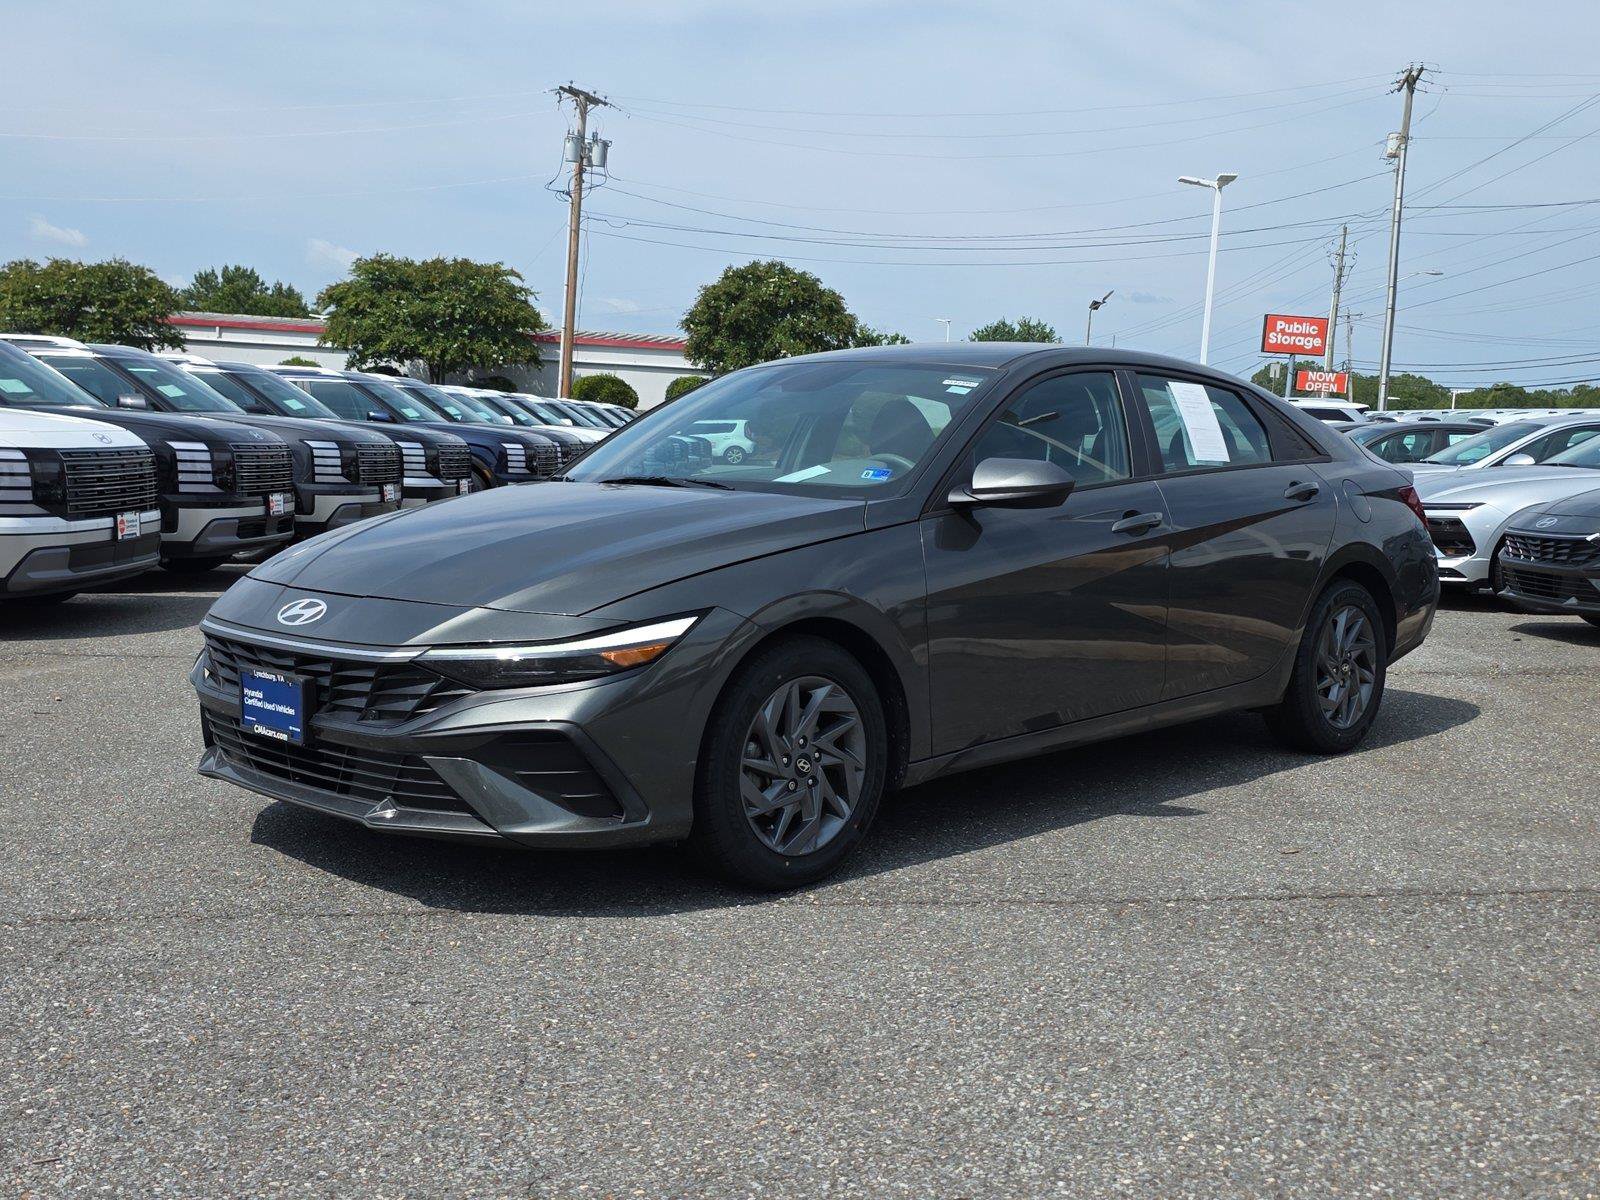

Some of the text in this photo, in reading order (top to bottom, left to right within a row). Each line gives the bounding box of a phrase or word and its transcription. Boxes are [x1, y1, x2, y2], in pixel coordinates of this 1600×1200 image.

[1276, 320, 1318, 335] Public
[1268, 333, 1322, 349] Storage
[1307, 371, 1336, 383] NOW
[1305, 382, 1337, 393] OPEN
[243, 687, 263, 699] Hyundai
[244, 697, 295, 715] Certified Used Vehicles
